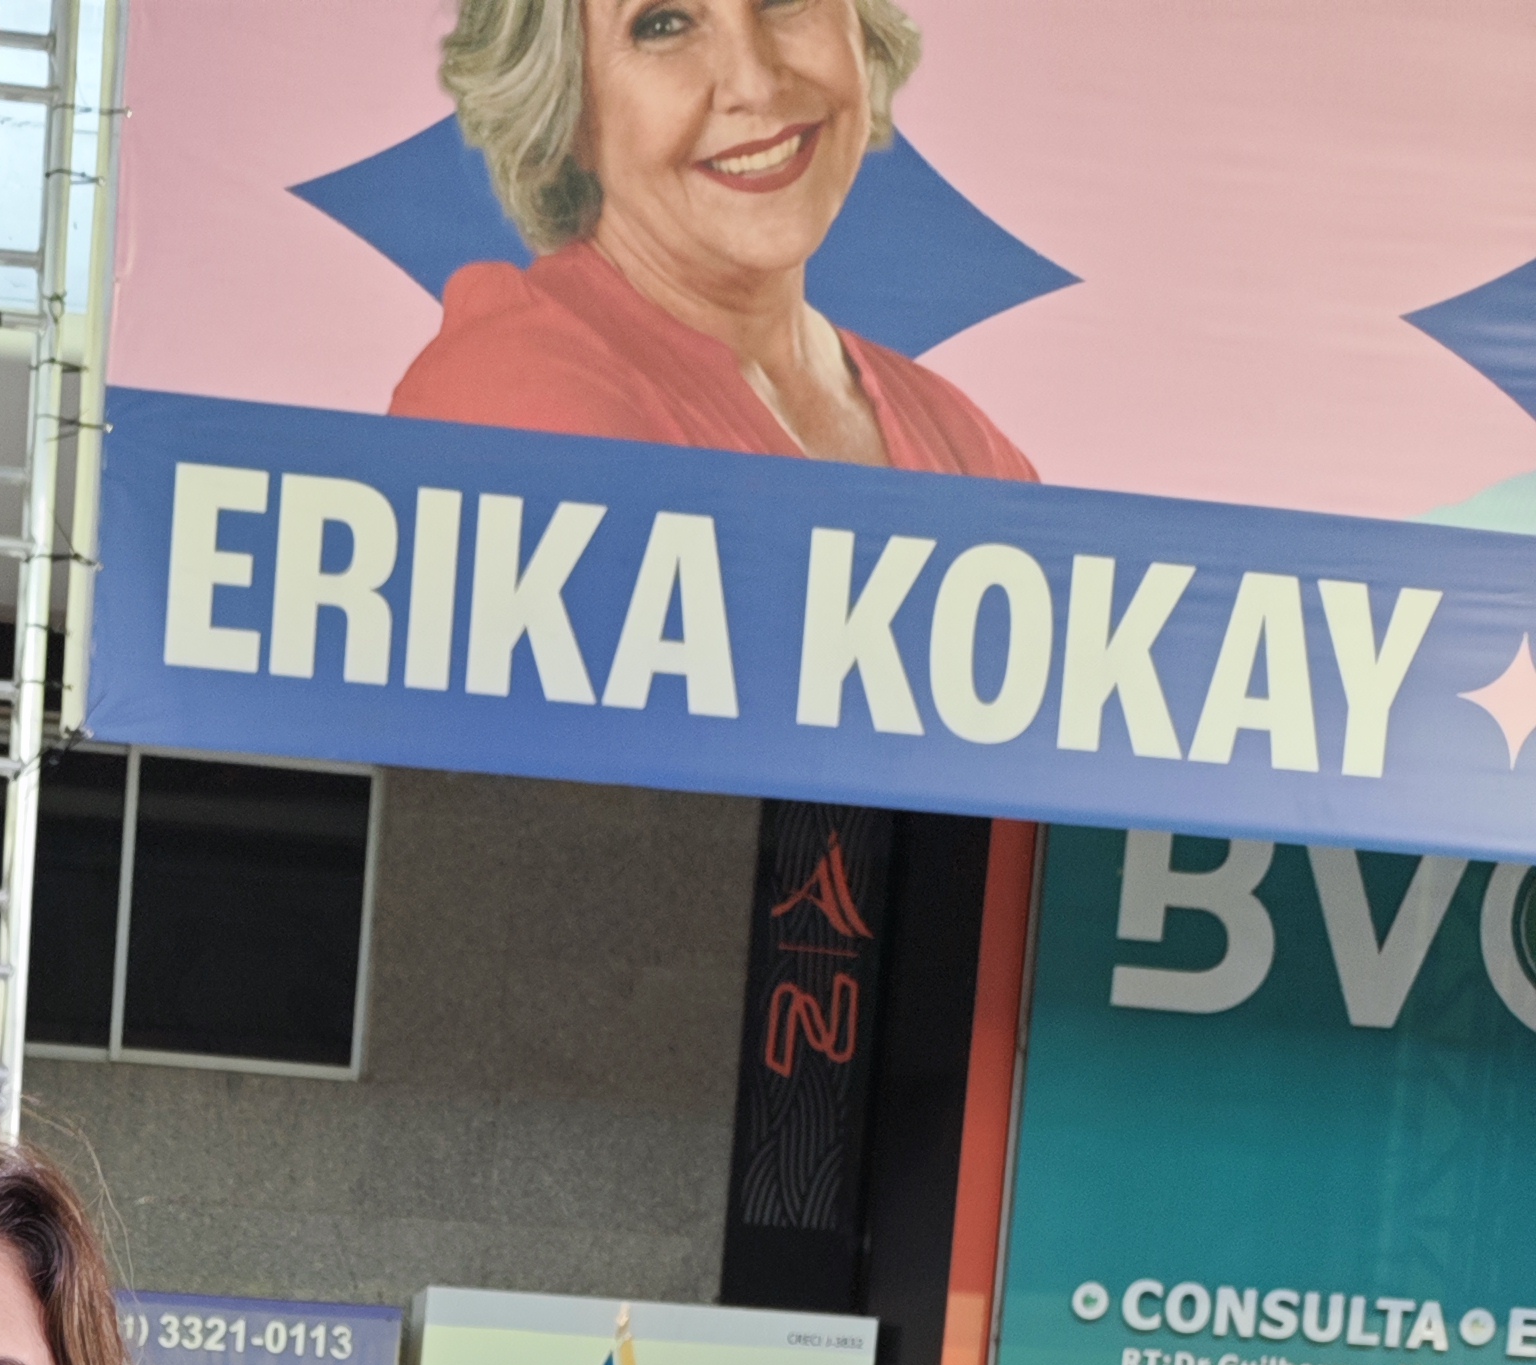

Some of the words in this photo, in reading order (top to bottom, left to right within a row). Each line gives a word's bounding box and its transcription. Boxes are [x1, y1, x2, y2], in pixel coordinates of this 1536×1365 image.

[164, 461, 740, 719] ERIKA
[795, 526, 1443, 779] KOKAY
[158, 1312, 353, 1360] 3321-0113
[1121, 1277, 1449, 1353] CONSULTA
